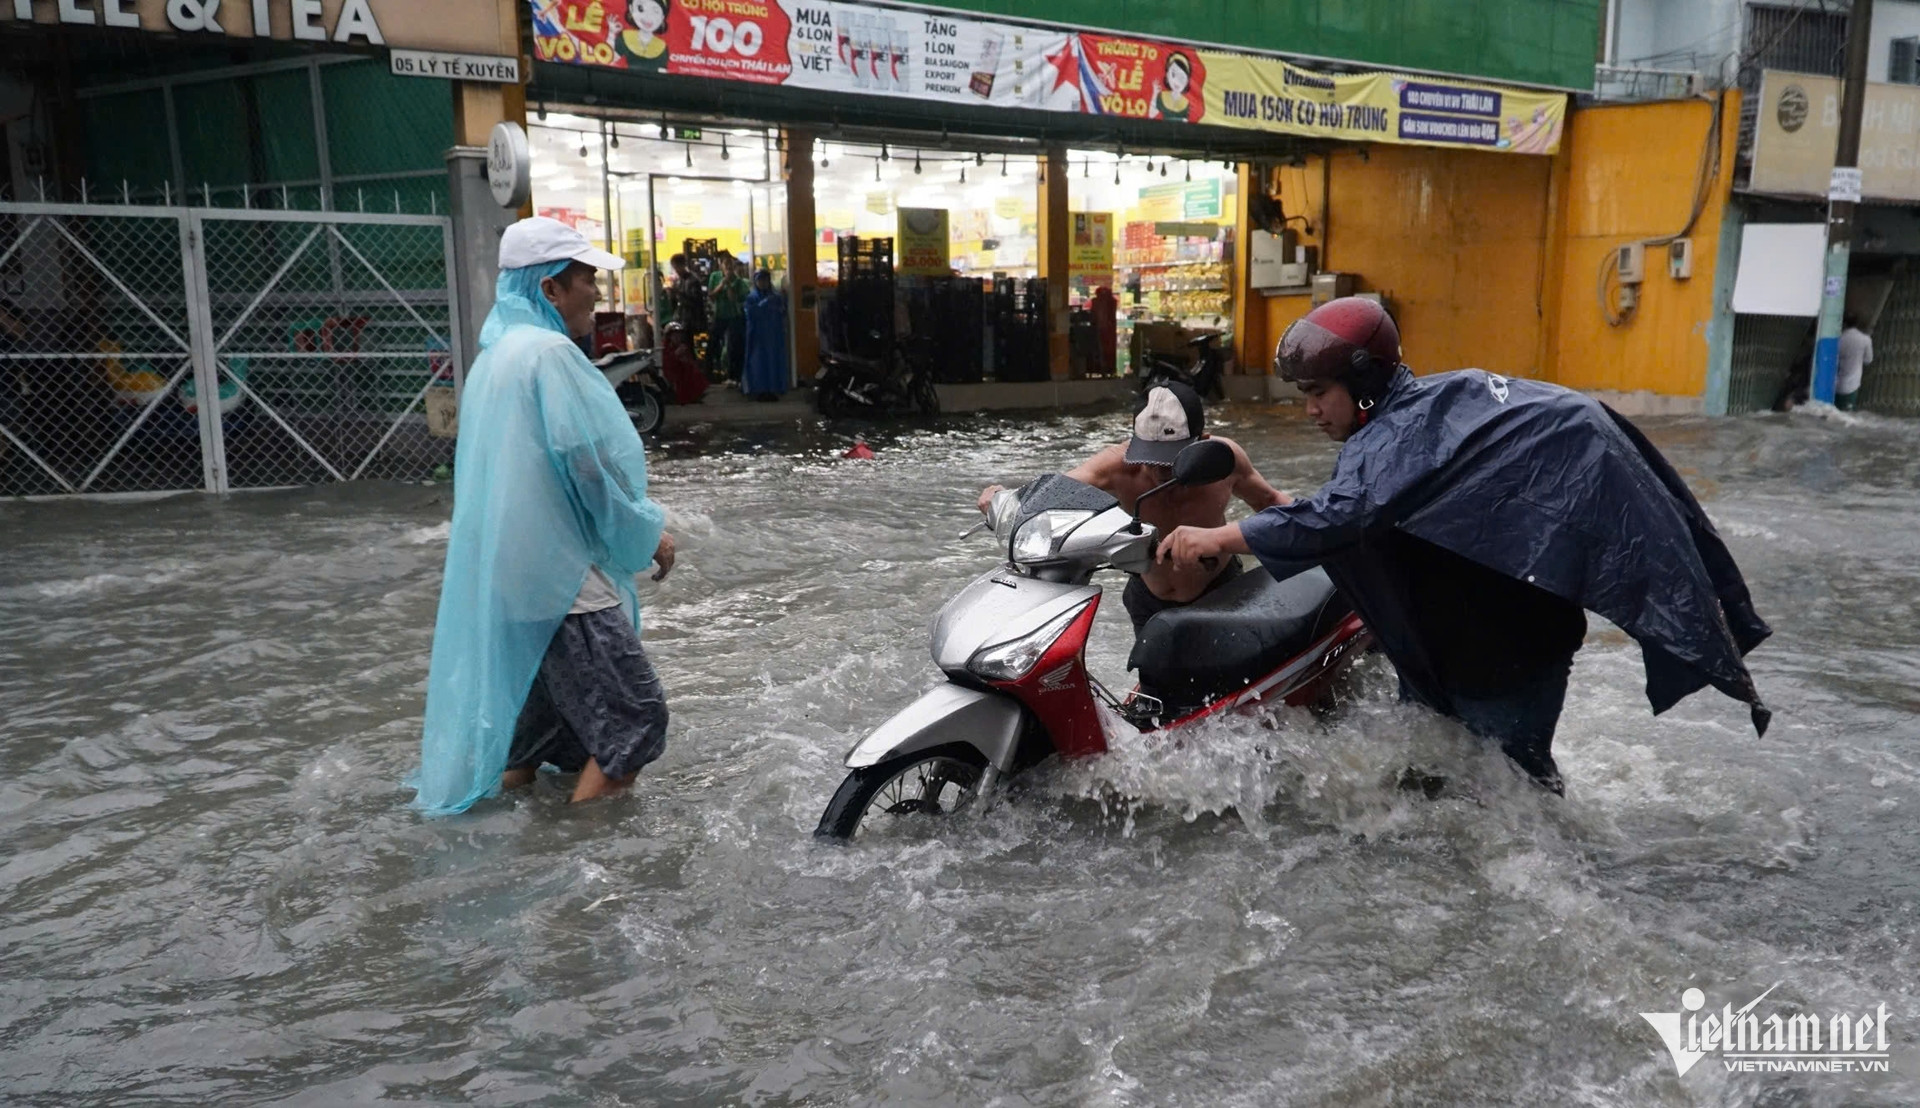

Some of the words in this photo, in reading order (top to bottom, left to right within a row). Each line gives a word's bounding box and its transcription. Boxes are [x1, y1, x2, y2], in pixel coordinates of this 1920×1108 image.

[166, 0, 225, 33] &
[727, 3, 768, 18] TRÚNG
[796, 8, 832, 27] MUA
[690, 15, 763, 57] 100
[797, 27, 804, 39] 6
[806, 28, 832, 42] LON
[924, 19, 957, 39] TẶNG
[579, 41, 614, 65] LO
[931, 42, 955, 55] LON
[395, 57, 414, 72] 05
[419, 56, 438, 73] LÝ
[443, 57, 461, 75] TẾ
[465, 61, 515, 79] XUYÊN
[741, 59, 766, 72] THÁI
[768, 63, 792, 74] LAN
[800, 54, 832, 73] VIỆT
[924, 57, 937, 67] BIA
[939, 58, 969, 70] SAIGON
[925, 70, 955, 81] EXPORT
[925, 83, 961, 94] PREMIUM
[1099, 92, 1123, 114] VÔ
[1125, 98, 1147, 116] LO
[1223, 90, 1257, 118] MUA
[1261, 94, 1293, 123] 150K
[1038, 683, 1076, 694] HONDA
